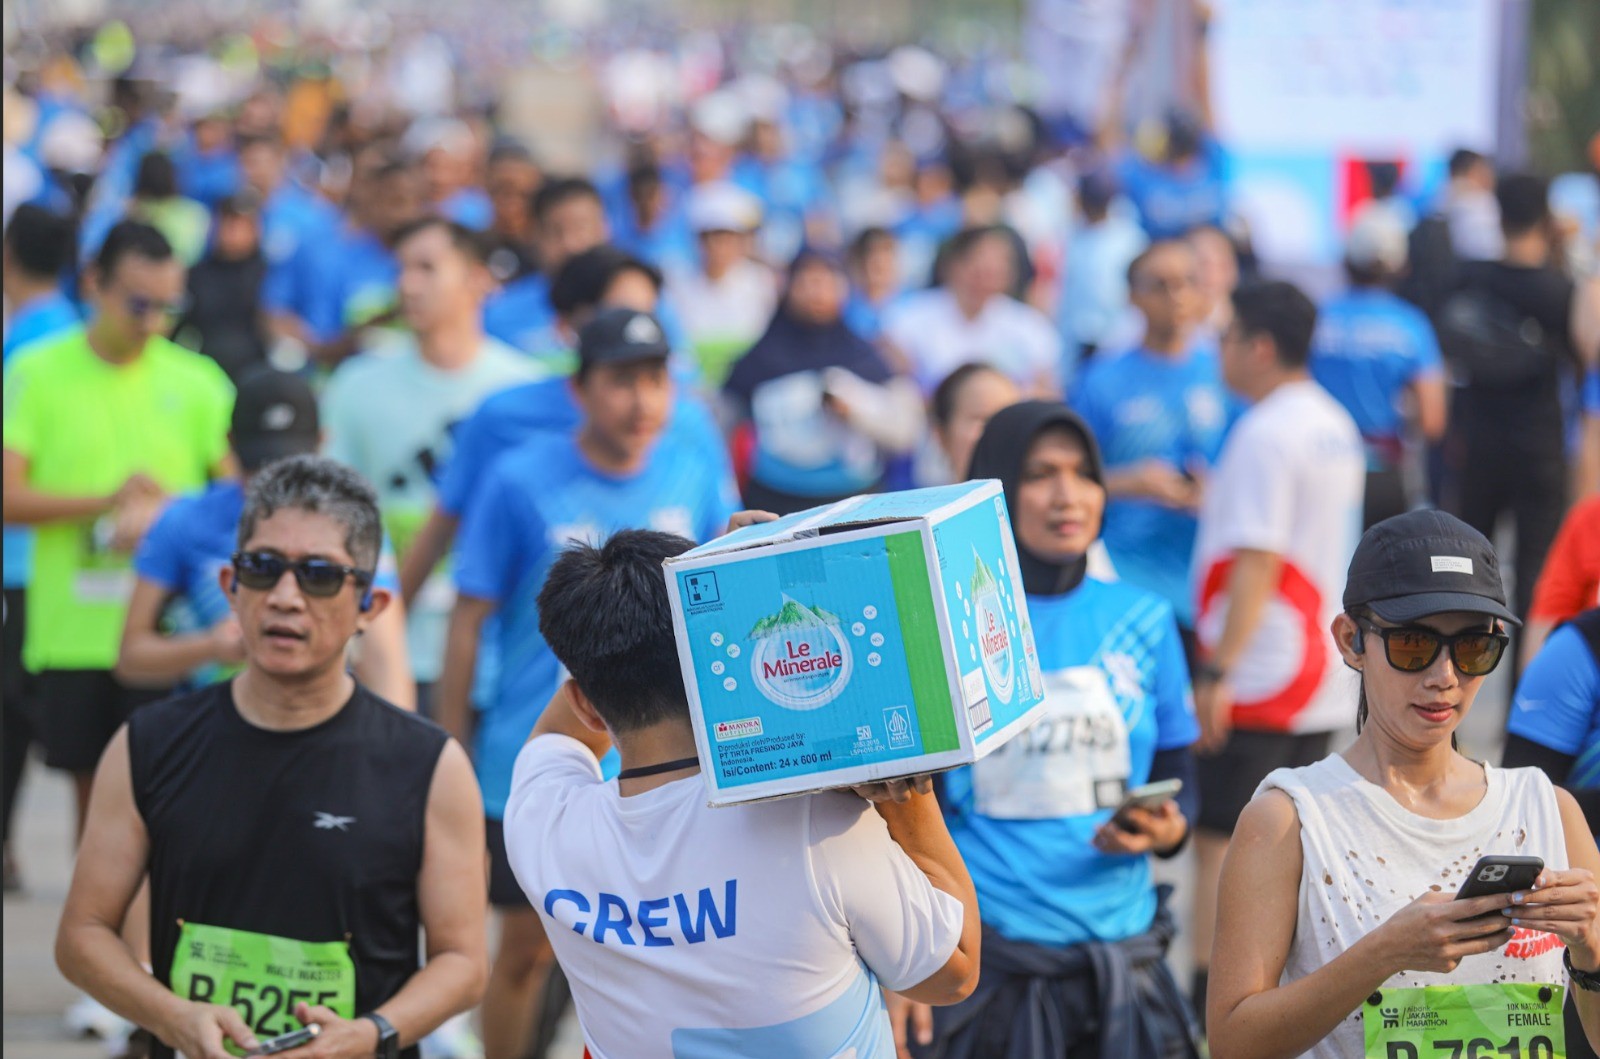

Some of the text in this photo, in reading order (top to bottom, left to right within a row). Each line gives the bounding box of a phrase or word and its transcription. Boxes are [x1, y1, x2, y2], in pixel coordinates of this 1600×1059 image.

[985, 609, 996, 632] Le
[786, 640, 810, 659] Le
[763, 651, 842, 679] Minerale
[719, 727, 758, 737] nutrition
[728, 720, 759, 731] MAYORA
[720, 740, 804, 760] PT TIRTA FRESINDO JAYA
[723, 750, 832, 778] Isi/Content: 24 x 600 ml
[544, 878, 737, 947] CREW
[1407, 1011, 1439, 1020] JAKARTA
[1507, 1003, 1520, 1011] 10K
[1406, 1019, 1448, 1027] MARATHON
[1507, 1012, 1551, 1027] FEMALE
